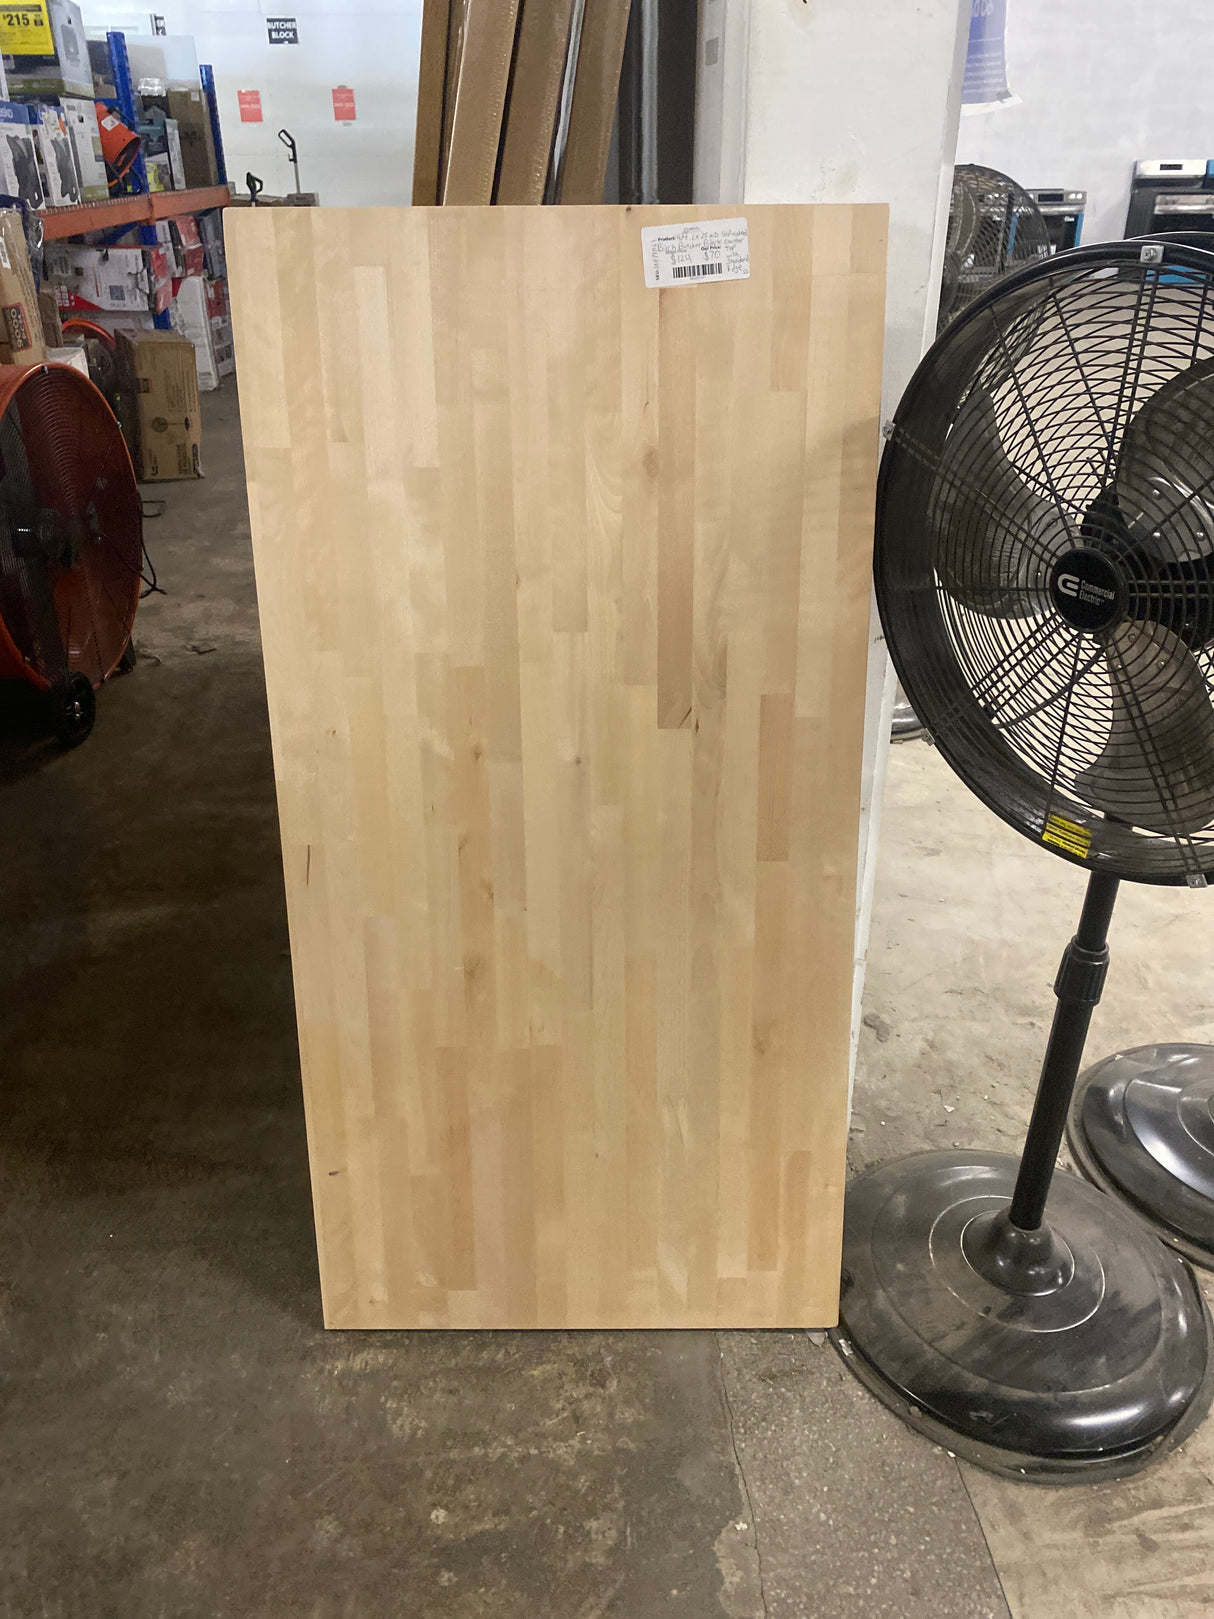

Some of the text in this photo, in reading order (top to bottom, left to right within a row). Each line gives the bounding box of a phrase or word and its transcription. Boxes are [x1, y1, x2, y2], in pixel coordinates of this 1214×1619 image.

[267, 21, 298, 29] BUTCHER
[272, 31, 294, 39] BLOCK
[704, 250, 721, 261] $70
[1081, 580, 1115, 600] Commercial
